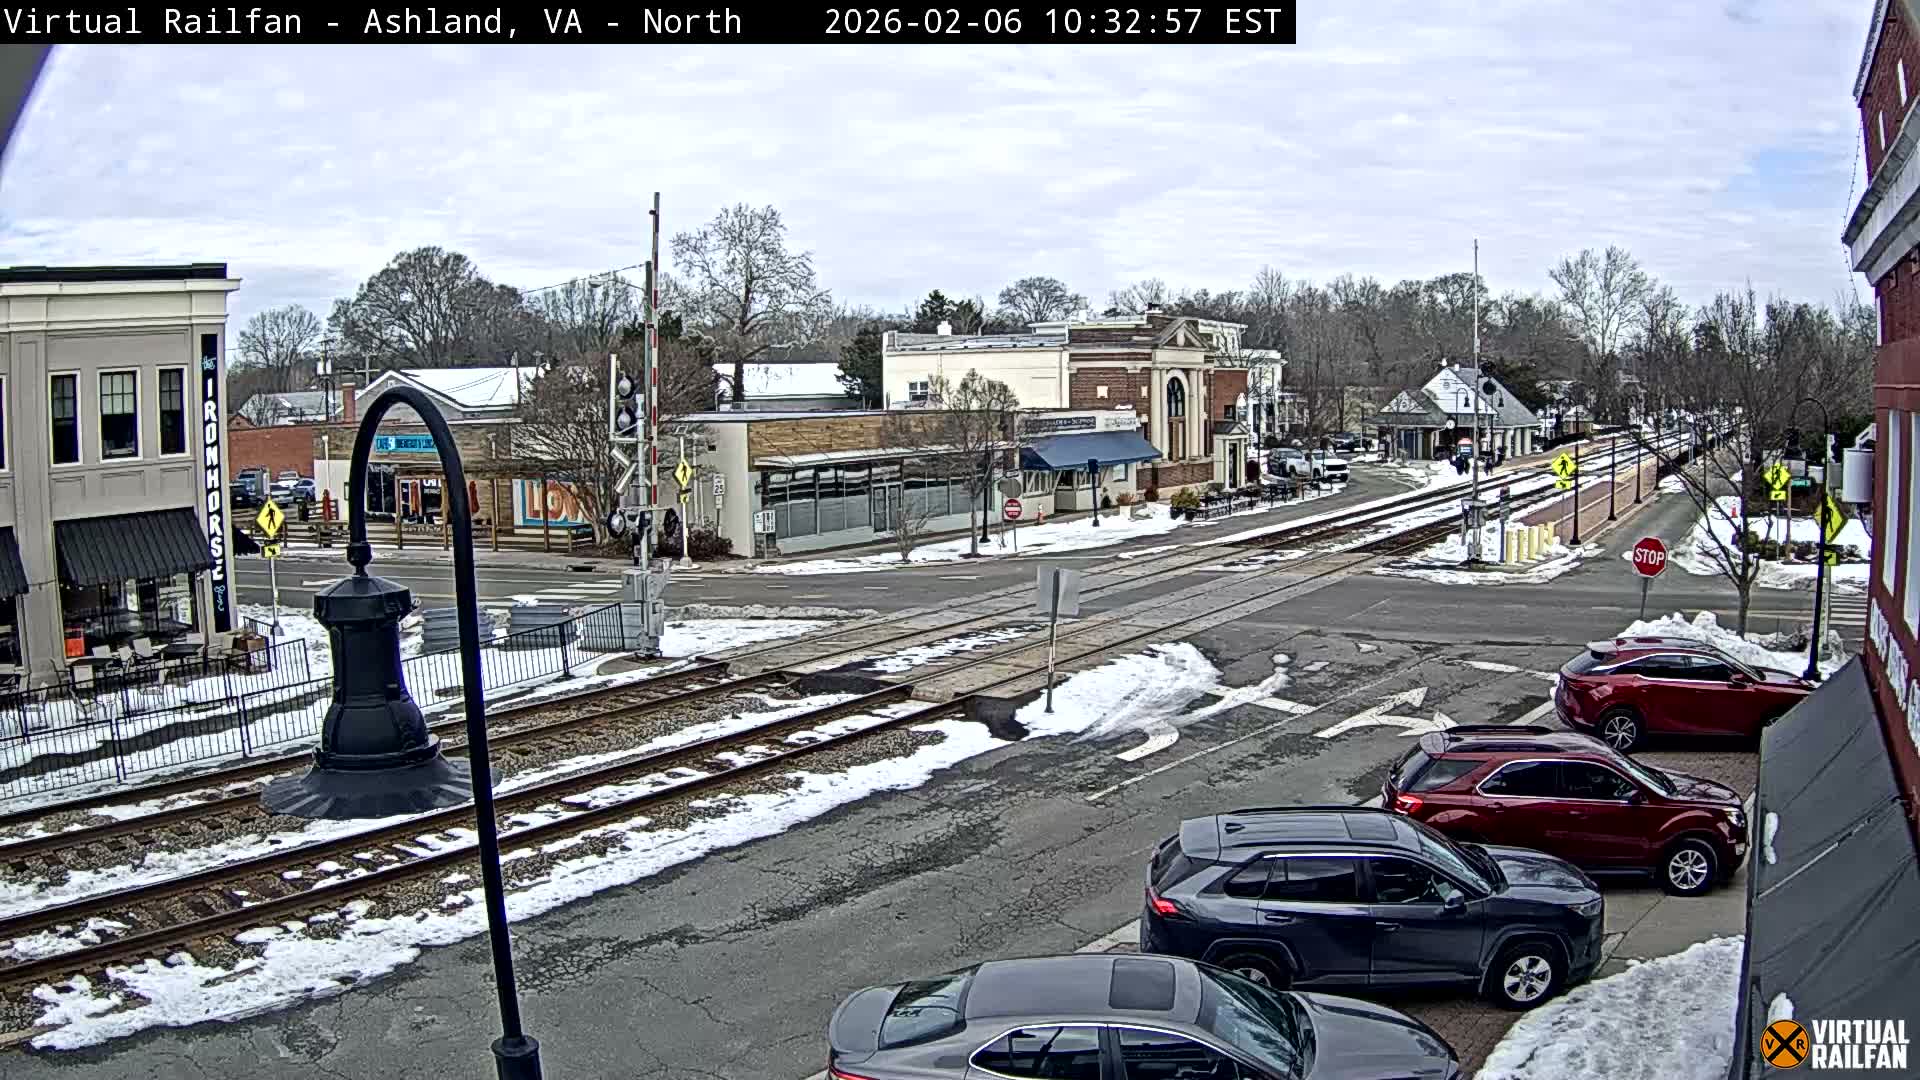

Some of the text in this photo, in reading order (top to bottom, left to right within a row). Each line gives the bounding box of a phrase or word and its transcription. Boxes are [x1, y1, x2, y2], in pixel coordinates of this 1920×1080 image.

[204, 378, 224, 581] IRONHORSE
[714, 484, 725, 494] 25
[1634, 547, 1665, 566] STOP
